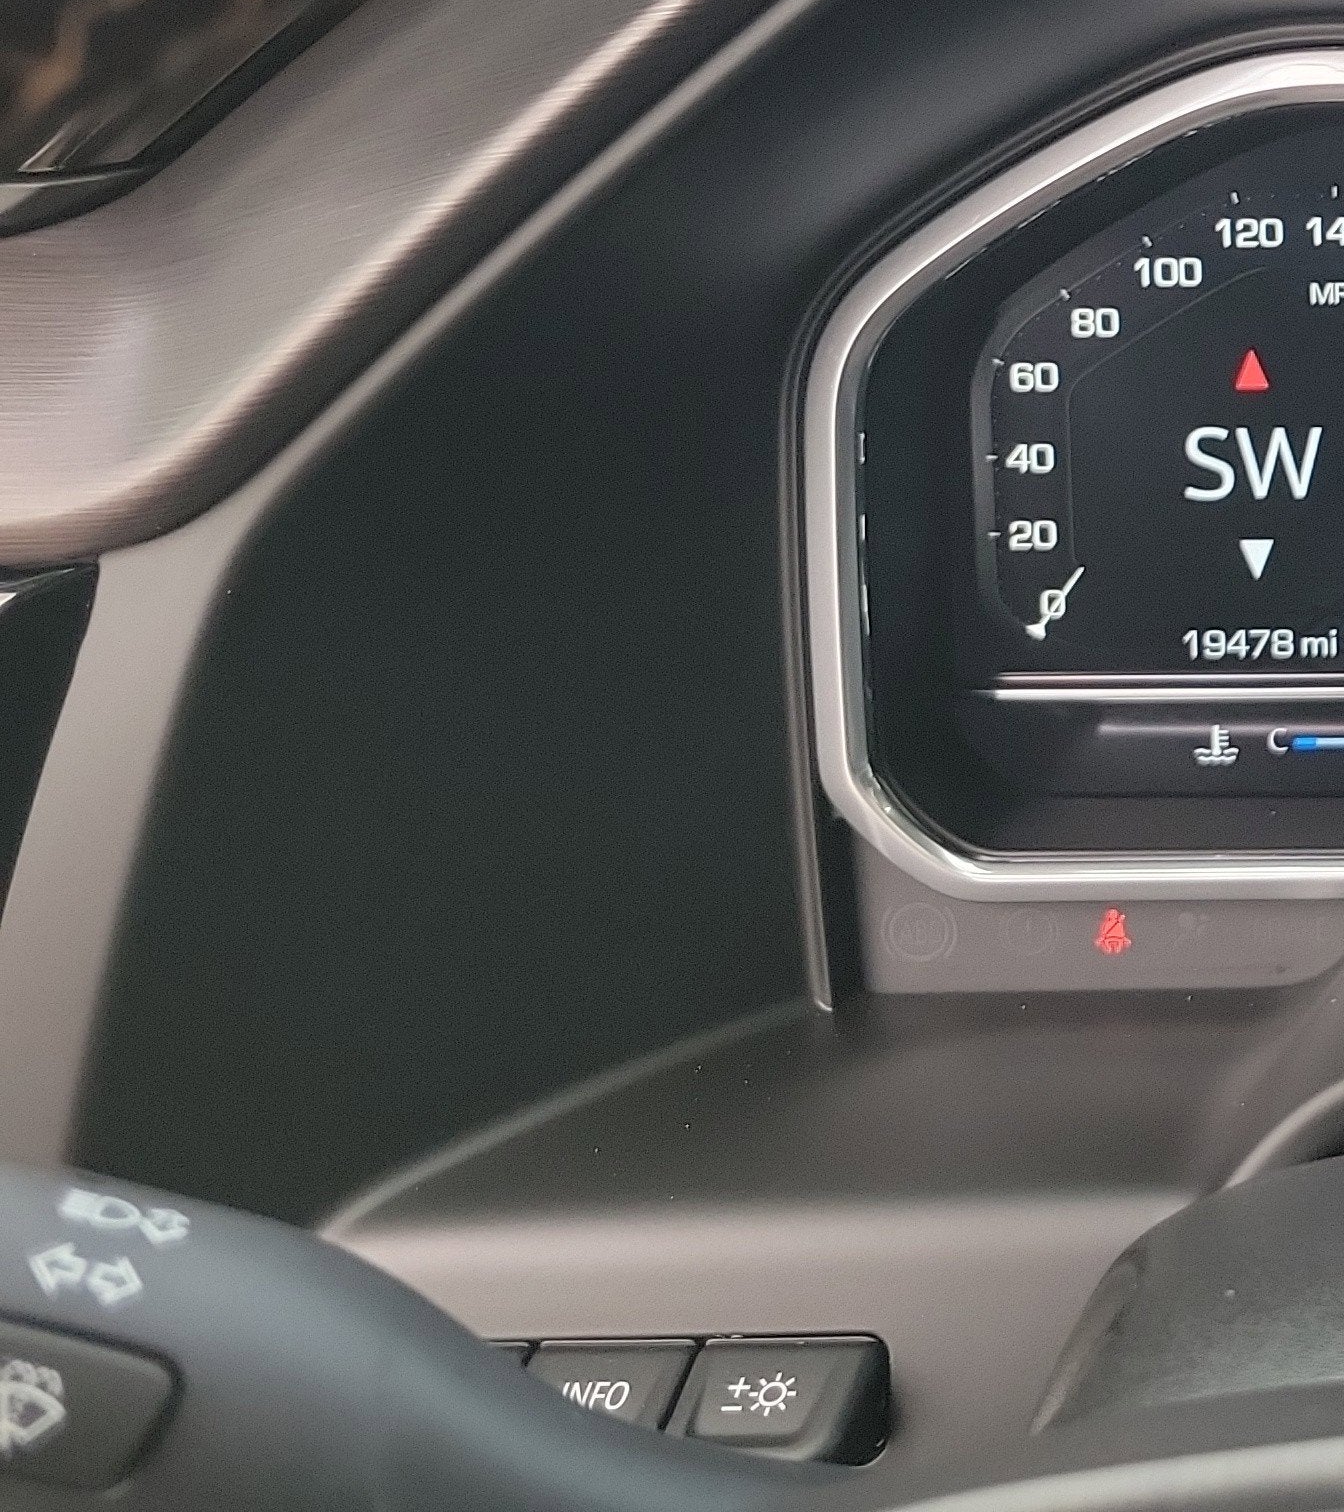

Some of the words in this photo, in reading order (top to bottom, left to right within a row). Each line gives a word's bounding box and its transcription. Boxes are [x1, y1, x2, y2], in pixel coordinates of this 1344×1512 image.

[1215, 217, 1285, 248] 120
[1133, 257, 1203, 288] 100
[1070, 307, 1121, 339] 80
[1009, 361, 1060, 393] 60
[1005, 443, 1056, 474] 40
[1183, 426, 1324, 502] SW
[1008, 520, 1058, 551] 20
[1039, 588, 1067, 620] 0
[1181, 628, 1295, 661] 19478
[1299, 628, 1338, 660] mi
[1266, 727, 1289, 755] C
[562, 1381, 630, 1411] INFO
